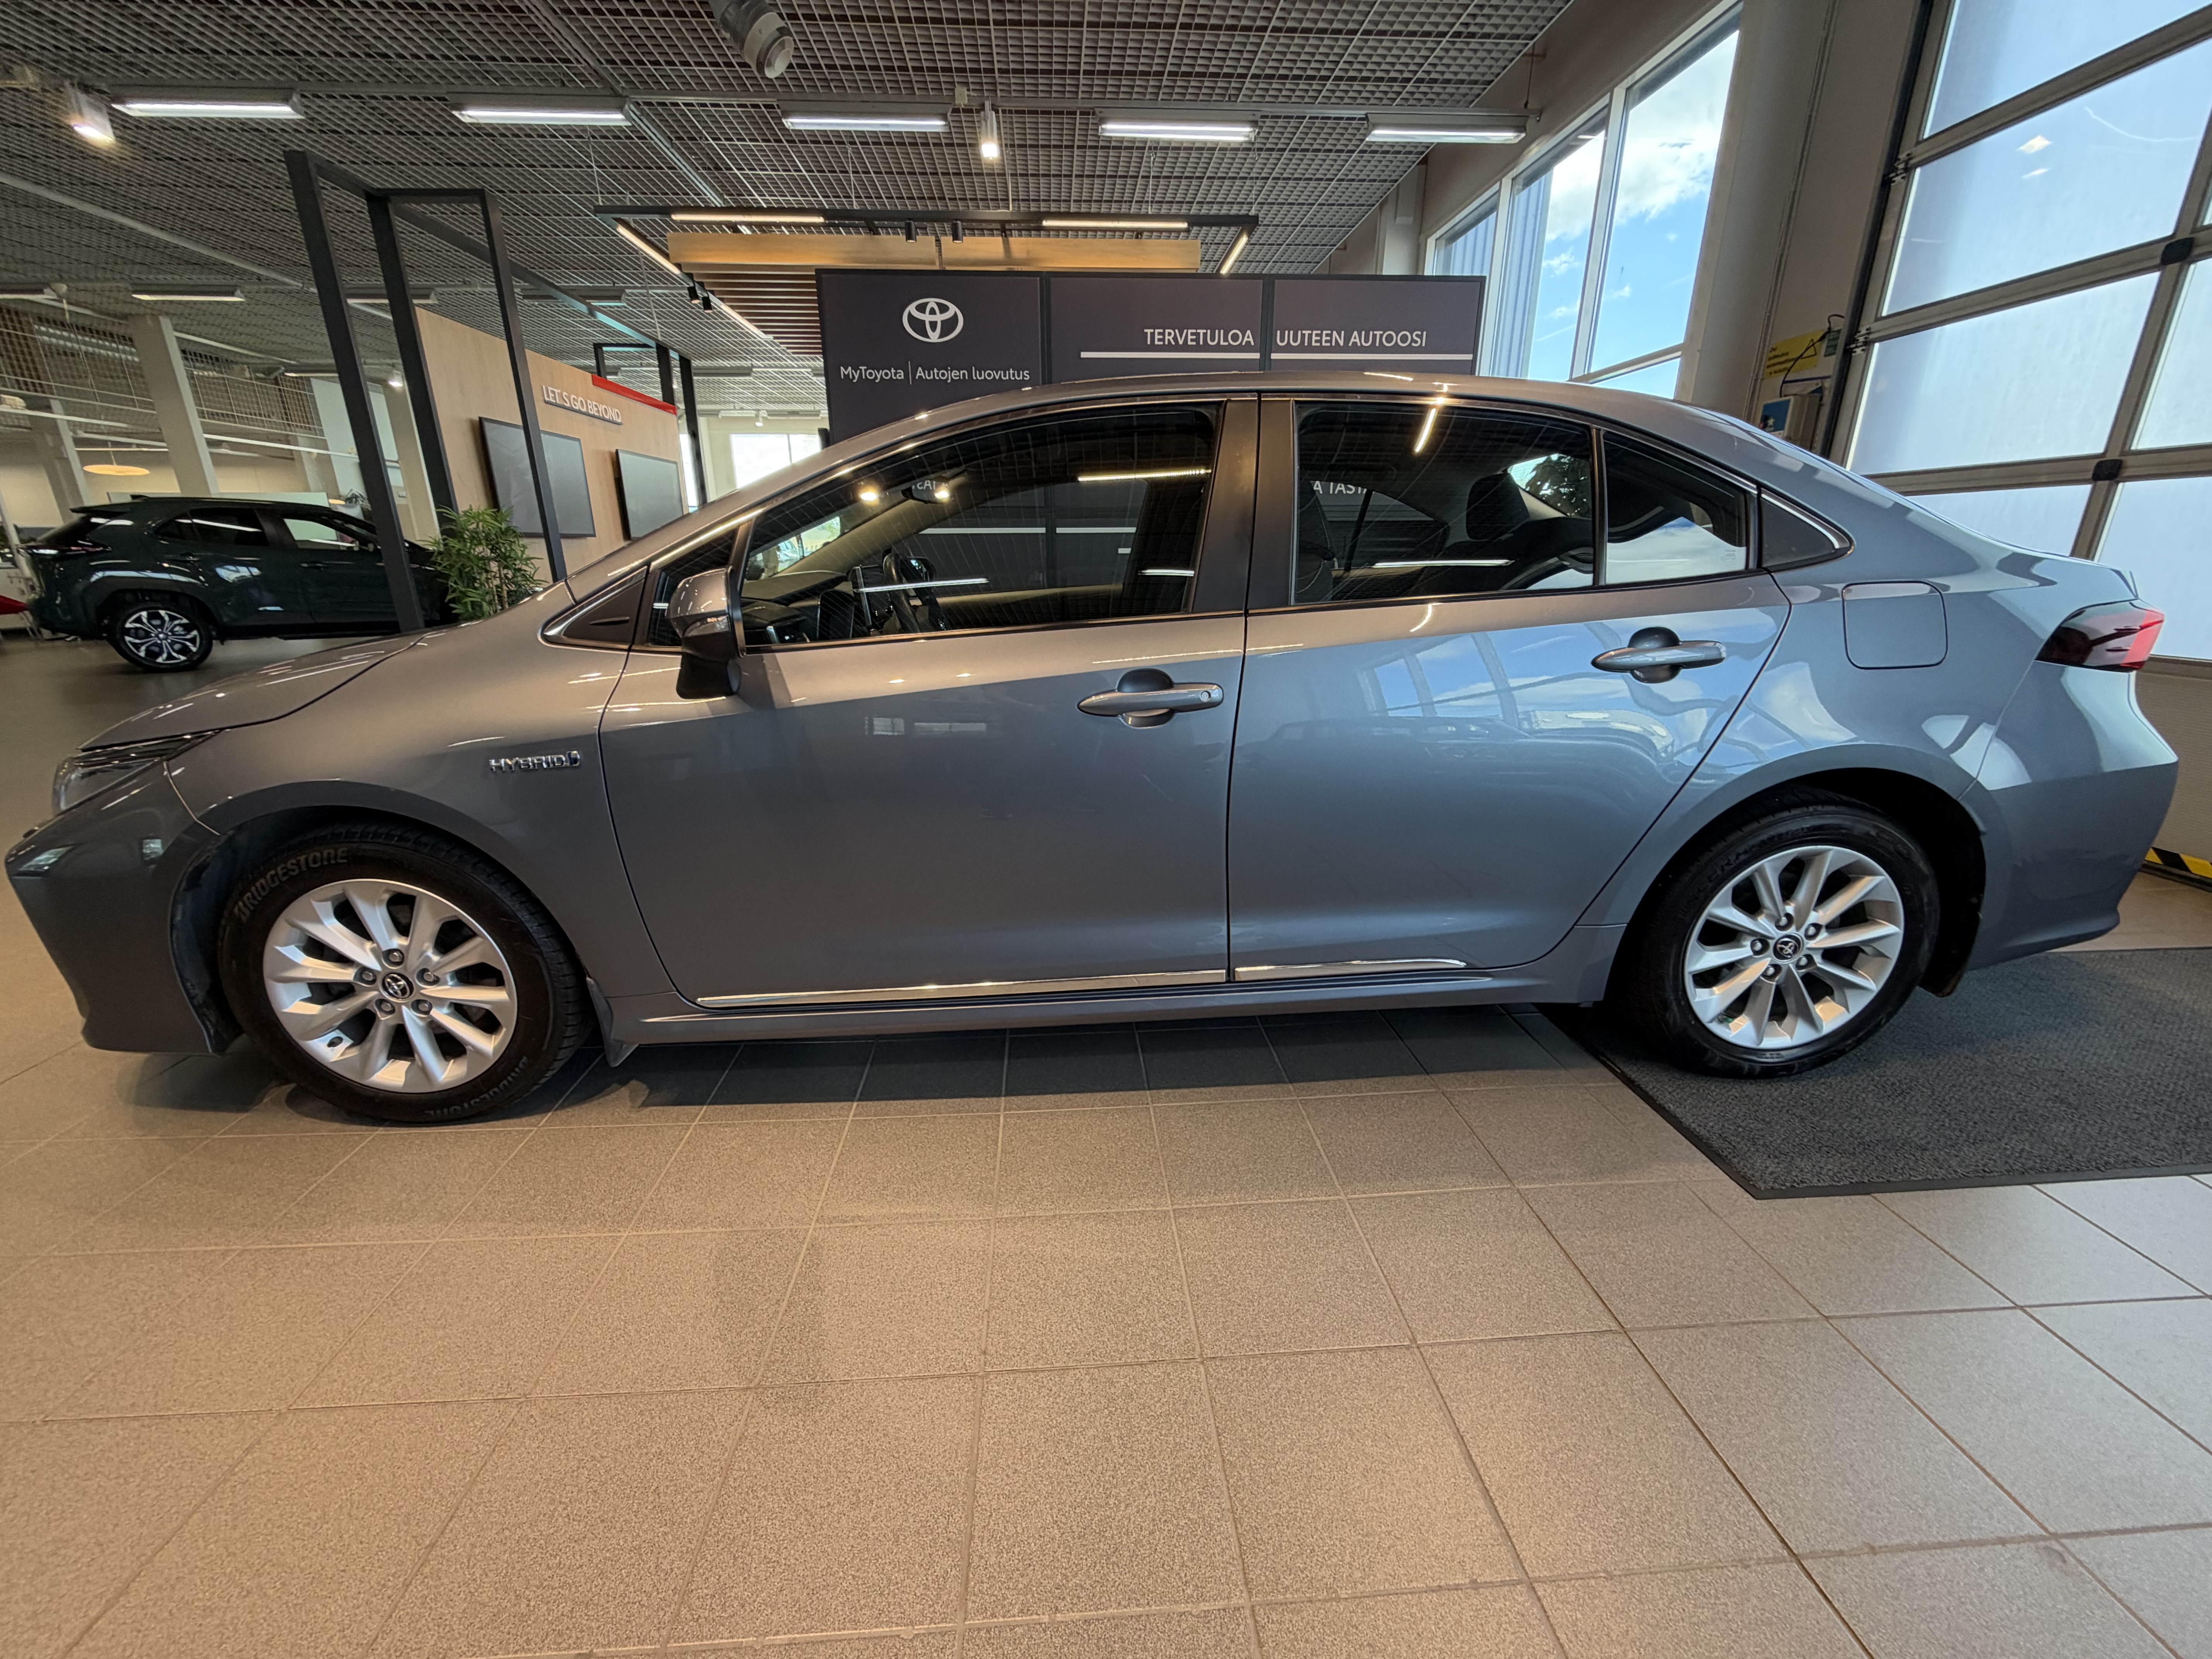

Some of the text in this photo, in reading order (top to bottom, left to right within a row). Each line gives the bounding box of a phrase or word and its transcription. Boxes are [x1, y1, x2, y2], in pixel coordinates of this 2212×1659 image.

[1144, 329, 1427, 347] TERVETULOA UUTEEN AUTOOSI
[840, 366, 1030, 383] MyToyota Autojen luovutus
[570, 394, 587, 412] GO
[587, 399, 622, 422] BEYOND
[489, 754, 566, 772] HYBRID
[233, 847, 349, 923] BRIDGESTONE
